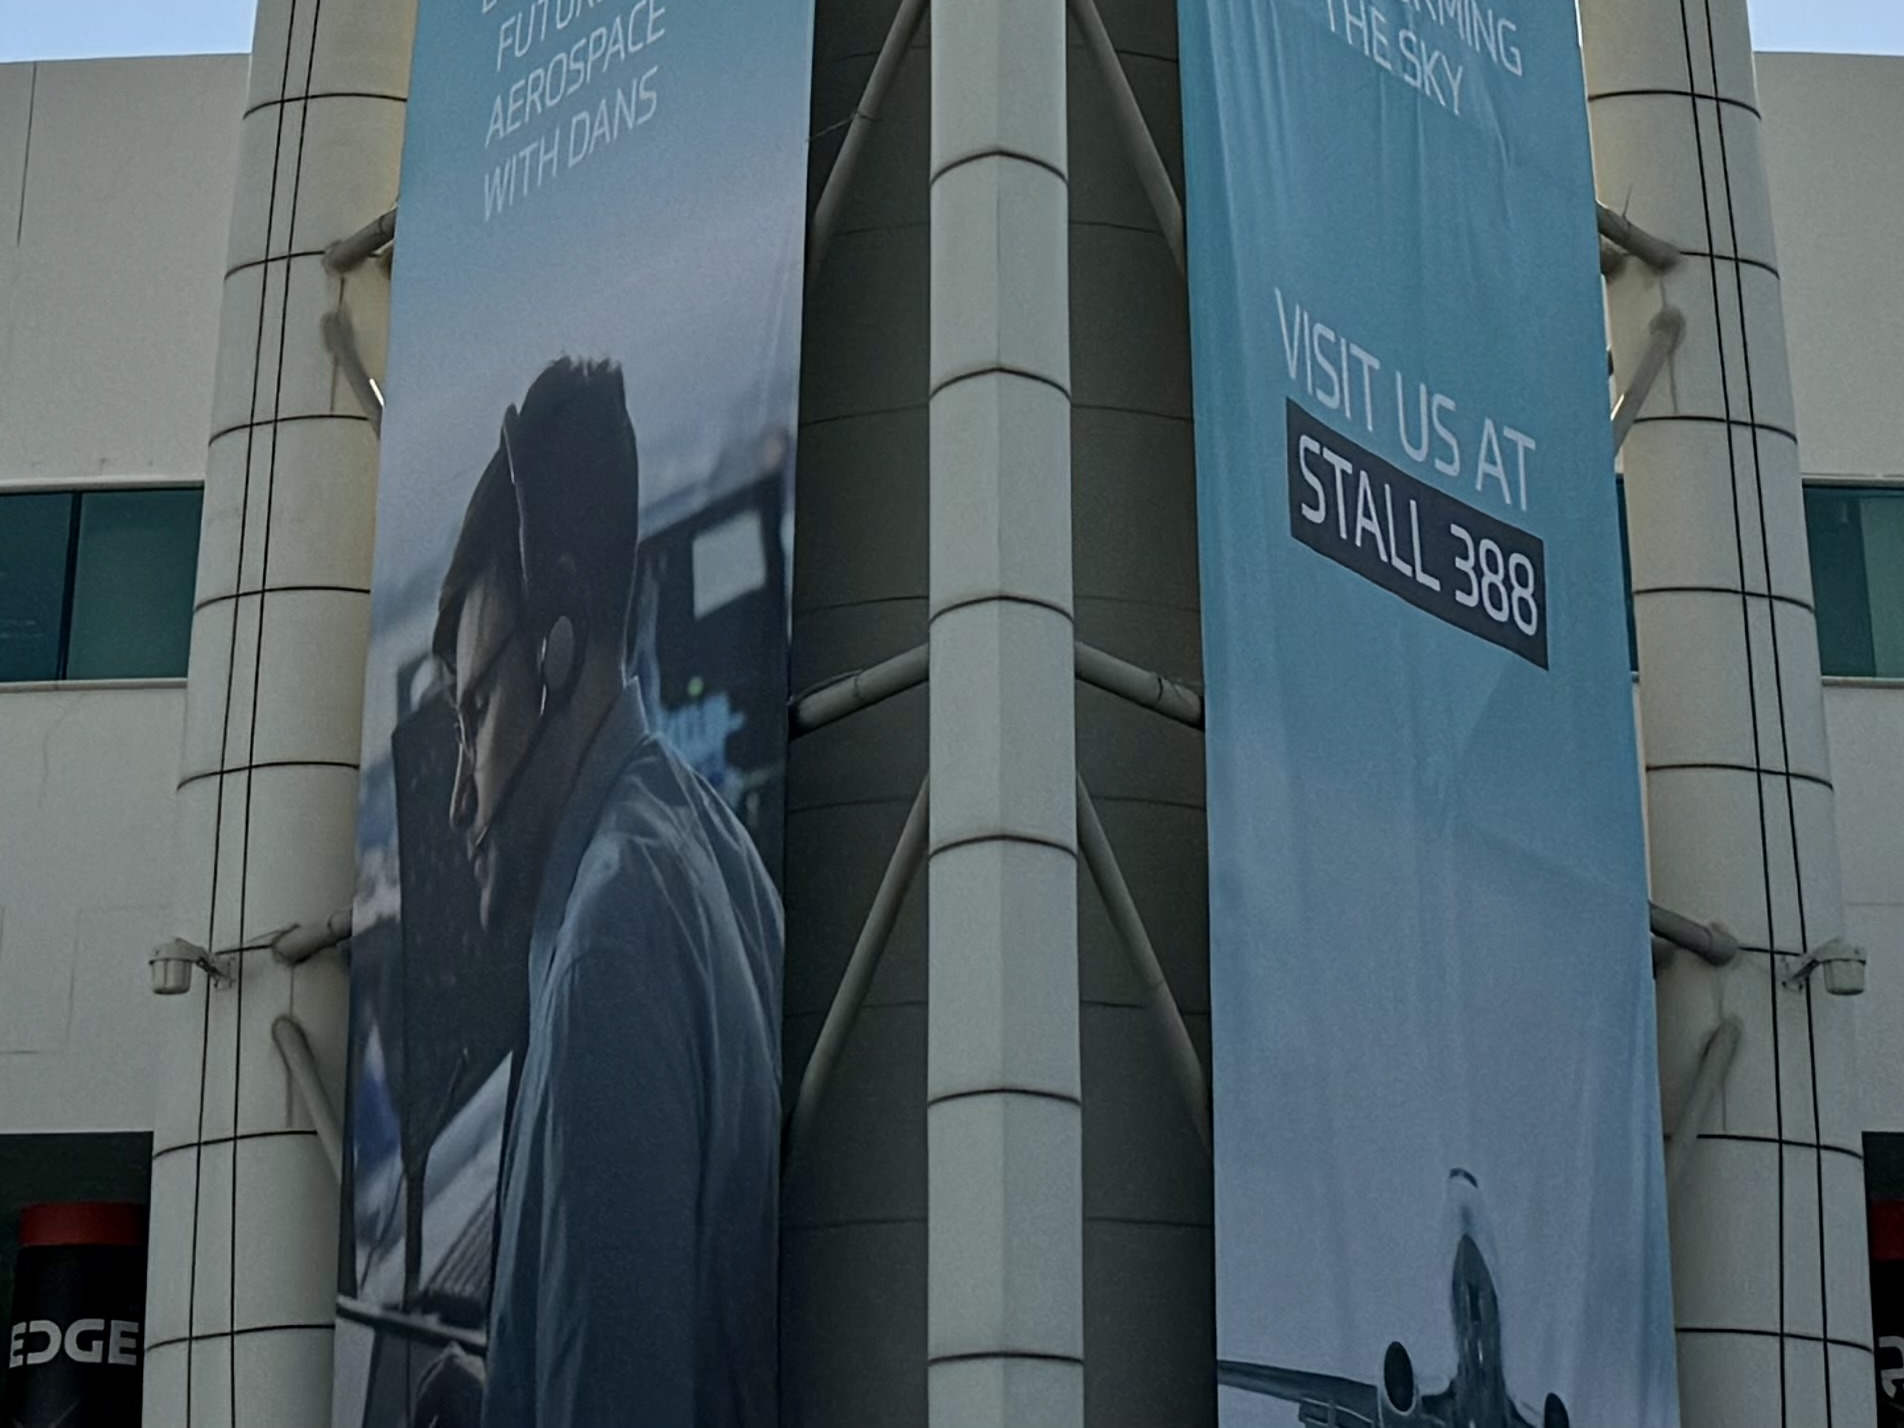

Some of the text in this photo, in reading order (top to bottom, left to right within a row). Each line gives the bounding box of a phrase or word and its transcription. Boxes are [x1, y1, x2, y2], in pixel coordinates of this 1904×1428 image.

[484, 65, 659, 223] WITH DANS
[1398, 29, 1464, 116] SKY
[1274, 286, 1536, 512] VISIT US AT
[1299, 434, 1538, 637] STALL 388
[9, 1318, 139, 1369] EDGE
